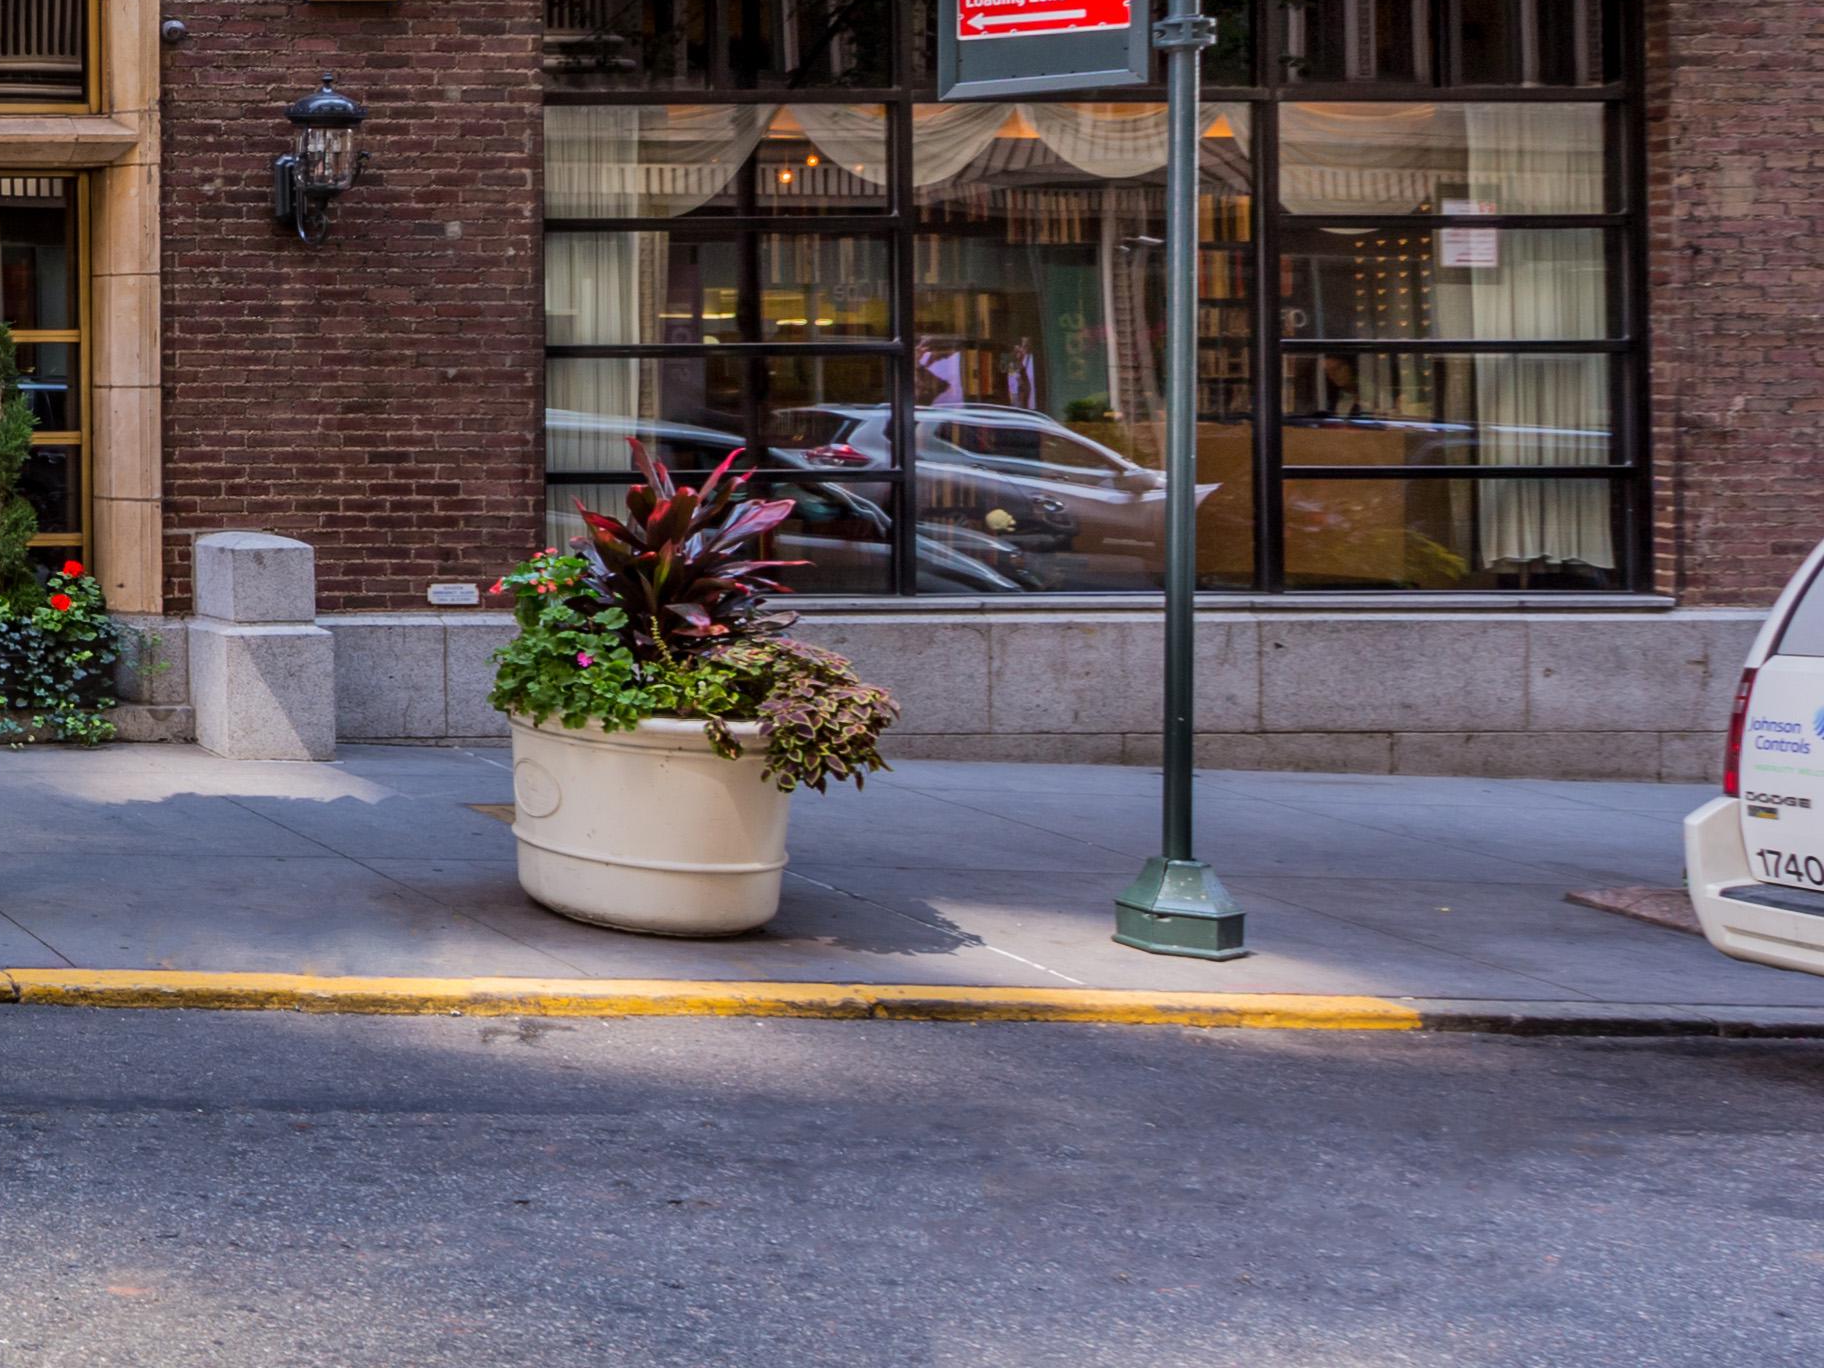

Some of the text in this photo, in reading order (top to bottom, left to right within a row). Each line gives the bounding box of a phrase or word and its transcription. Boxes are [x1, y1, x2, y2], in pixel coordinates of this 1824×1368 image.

[1750, 716, 1802, 733] Johnson
[1755, 735, 1811, 754] Controls
[1745, 791, 1812, 809] DODGE
[1756, 847, 1824, 886] 1740
